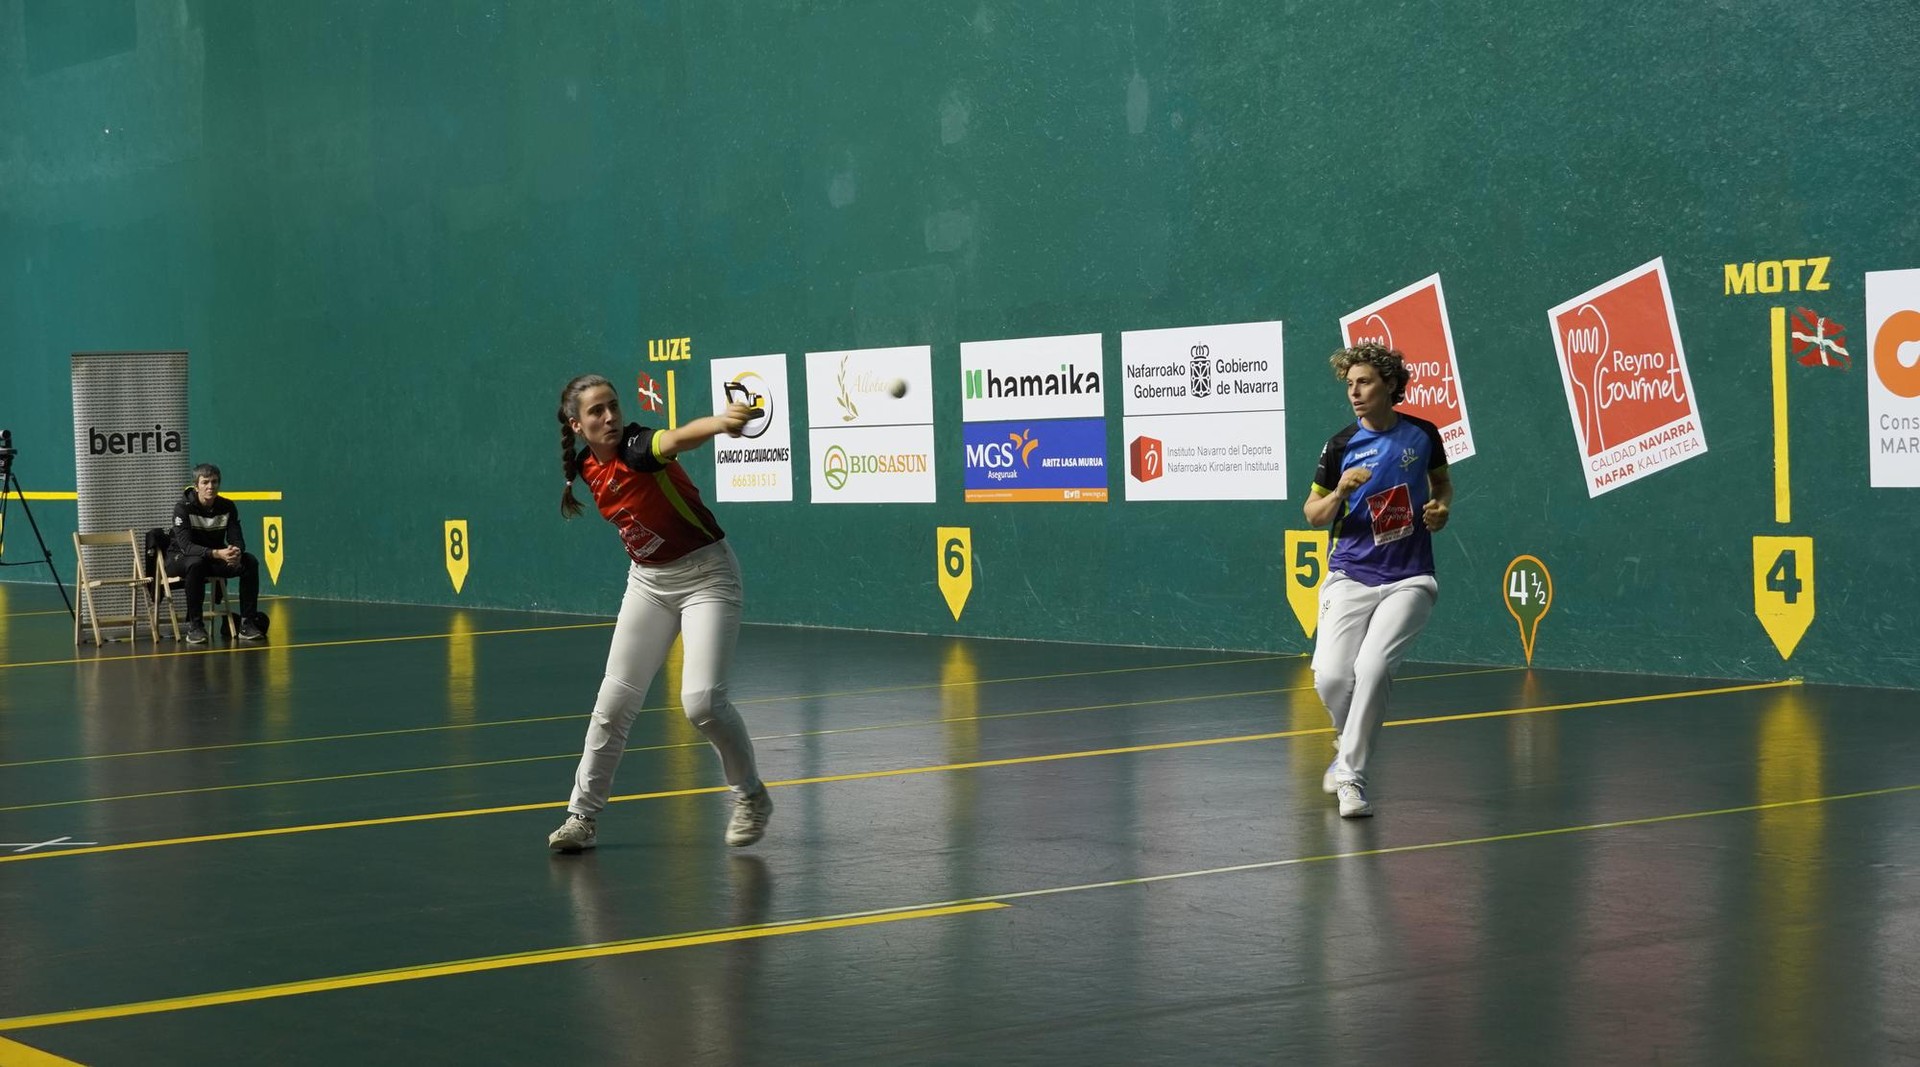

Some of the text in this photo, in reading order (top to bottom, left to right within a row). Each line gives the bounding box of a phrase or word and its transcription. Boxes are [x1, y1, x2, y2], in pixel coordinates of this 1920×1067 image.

[1724, 256, 1832, 295] MOTZ
[648, 337, 692, 361] LUZE
[1127, 362, 1186, 378] Nafarroako
[1216, 358, 1268, 374] Gobierno
[1401, 360, 1440, 383] eyno
[1613, 350, 1664, 376] Reyno
[987, 364, 1100, 398] hamaika
[1134, 383, 1187, 399] Gobernua
[1216, 379, 1279, 395] de Navarra
[1398, 362, 1457, 409] urmet
[1599, 353, 1686, 409] Gourmet
[89, 424, 182, 456] berria
[1167, 444, 1272, 457] Instituto Navarro del Deporte
[1591, 420, 1695, 473] CALIDAD NAVARRA
[717, 448, 789, 464] IGNACIO EXCAVACIONES
[850, 454, 927, 474] BIOSASUN
[966, 443, 1014, 468] MGS
[1042, 457, 1104, 467] ARITZ LASA MURUA
[1167, 461, 1279, 473] Nafarroako Kirolaren Institutua
[1595, 437, 1700, 489] NAFAR KALITATEA
[988, 469, 1018, 481] Aseguruak
[268, 524, 279, 553] 9
[450, 528, 463, 561] 8
[944, 537, 964, 578] 6
[1295, 541, 1320, 588] 5
[1766, 549, 1802, 605] 4
